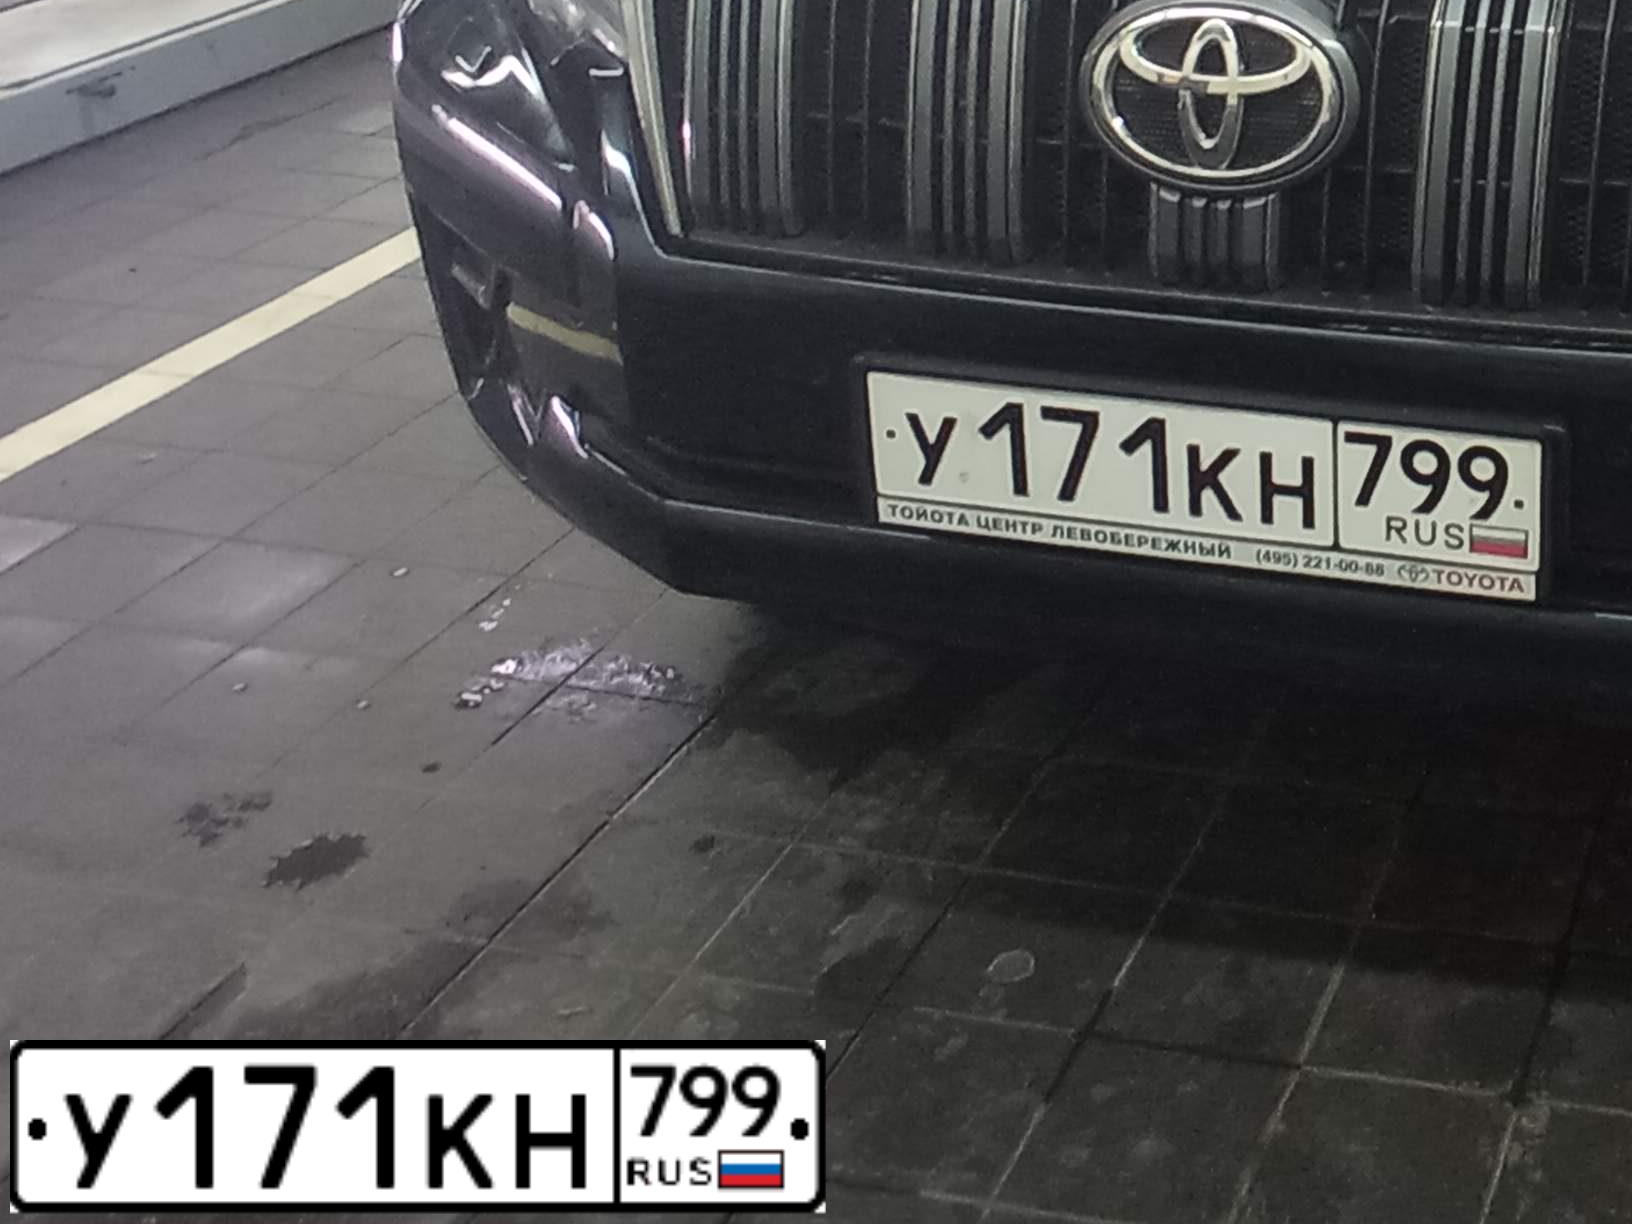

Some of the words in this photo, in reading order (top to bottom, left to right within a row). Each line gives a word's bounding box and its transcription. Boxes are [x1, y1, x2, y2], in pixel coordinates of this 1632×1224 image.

[1344, 431, 1510, 520] 799
[887, 503, 970, 527] ТОЙОТА
[976, 515, 1044, 536] ЦЕНТР
[1051, 526, 1233, 560] ЛЕВОБЕРЕЖНЫЙ
[1255, 548, 1298, 568] (495)
[1385, 516, 1464, 550] RUS
[1433, 569, 1525, 594] TOYOTA
